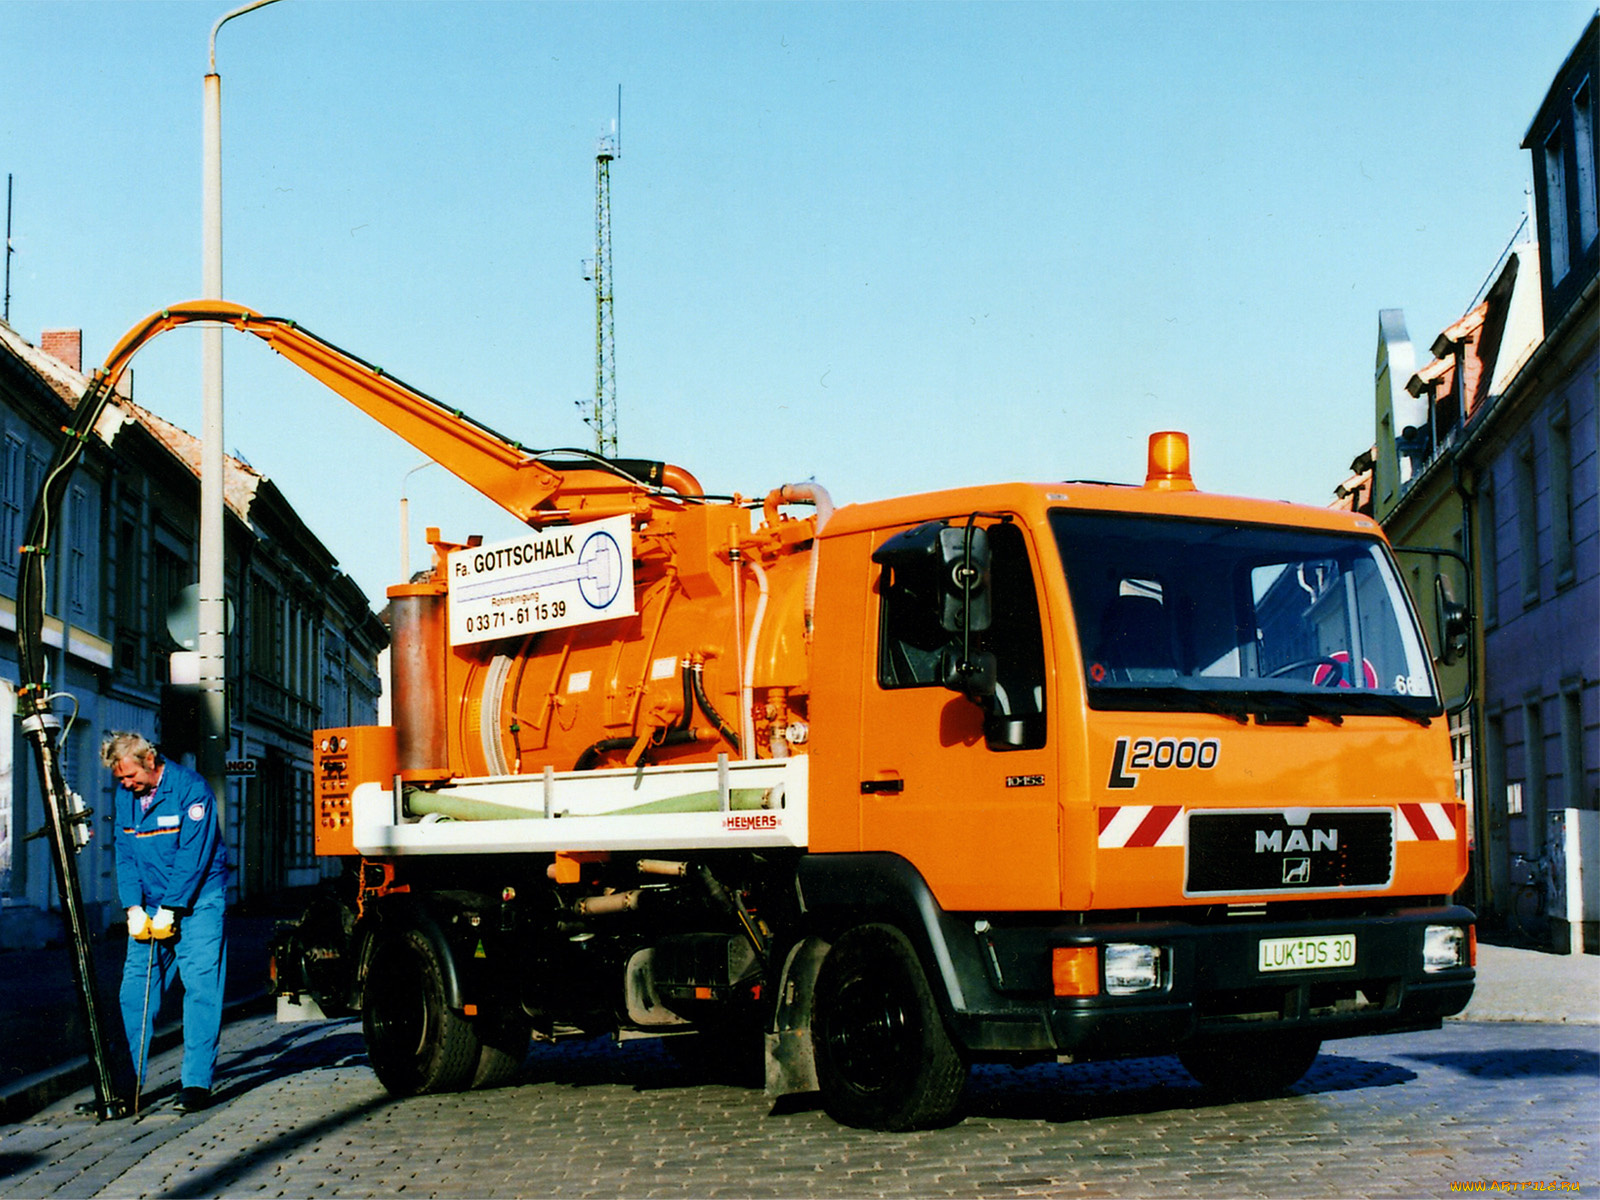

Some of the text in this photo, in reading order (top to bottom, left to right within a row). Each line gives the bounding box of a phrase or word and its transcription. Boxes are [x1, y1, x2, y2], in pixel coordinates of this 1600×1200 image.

[456, 534, 575, 577] Fa. GOTTSCHALK
[466, 616, 474, 632] 0
[476, 613, 490, 631] 33
[493, 611, 505, 628] 71
[517, 607, 530, 624] 61
[535, 603, 549, 620] 15
[551, 600, 566, 617] 39
[1255, 828, 1338, 853] MAN
